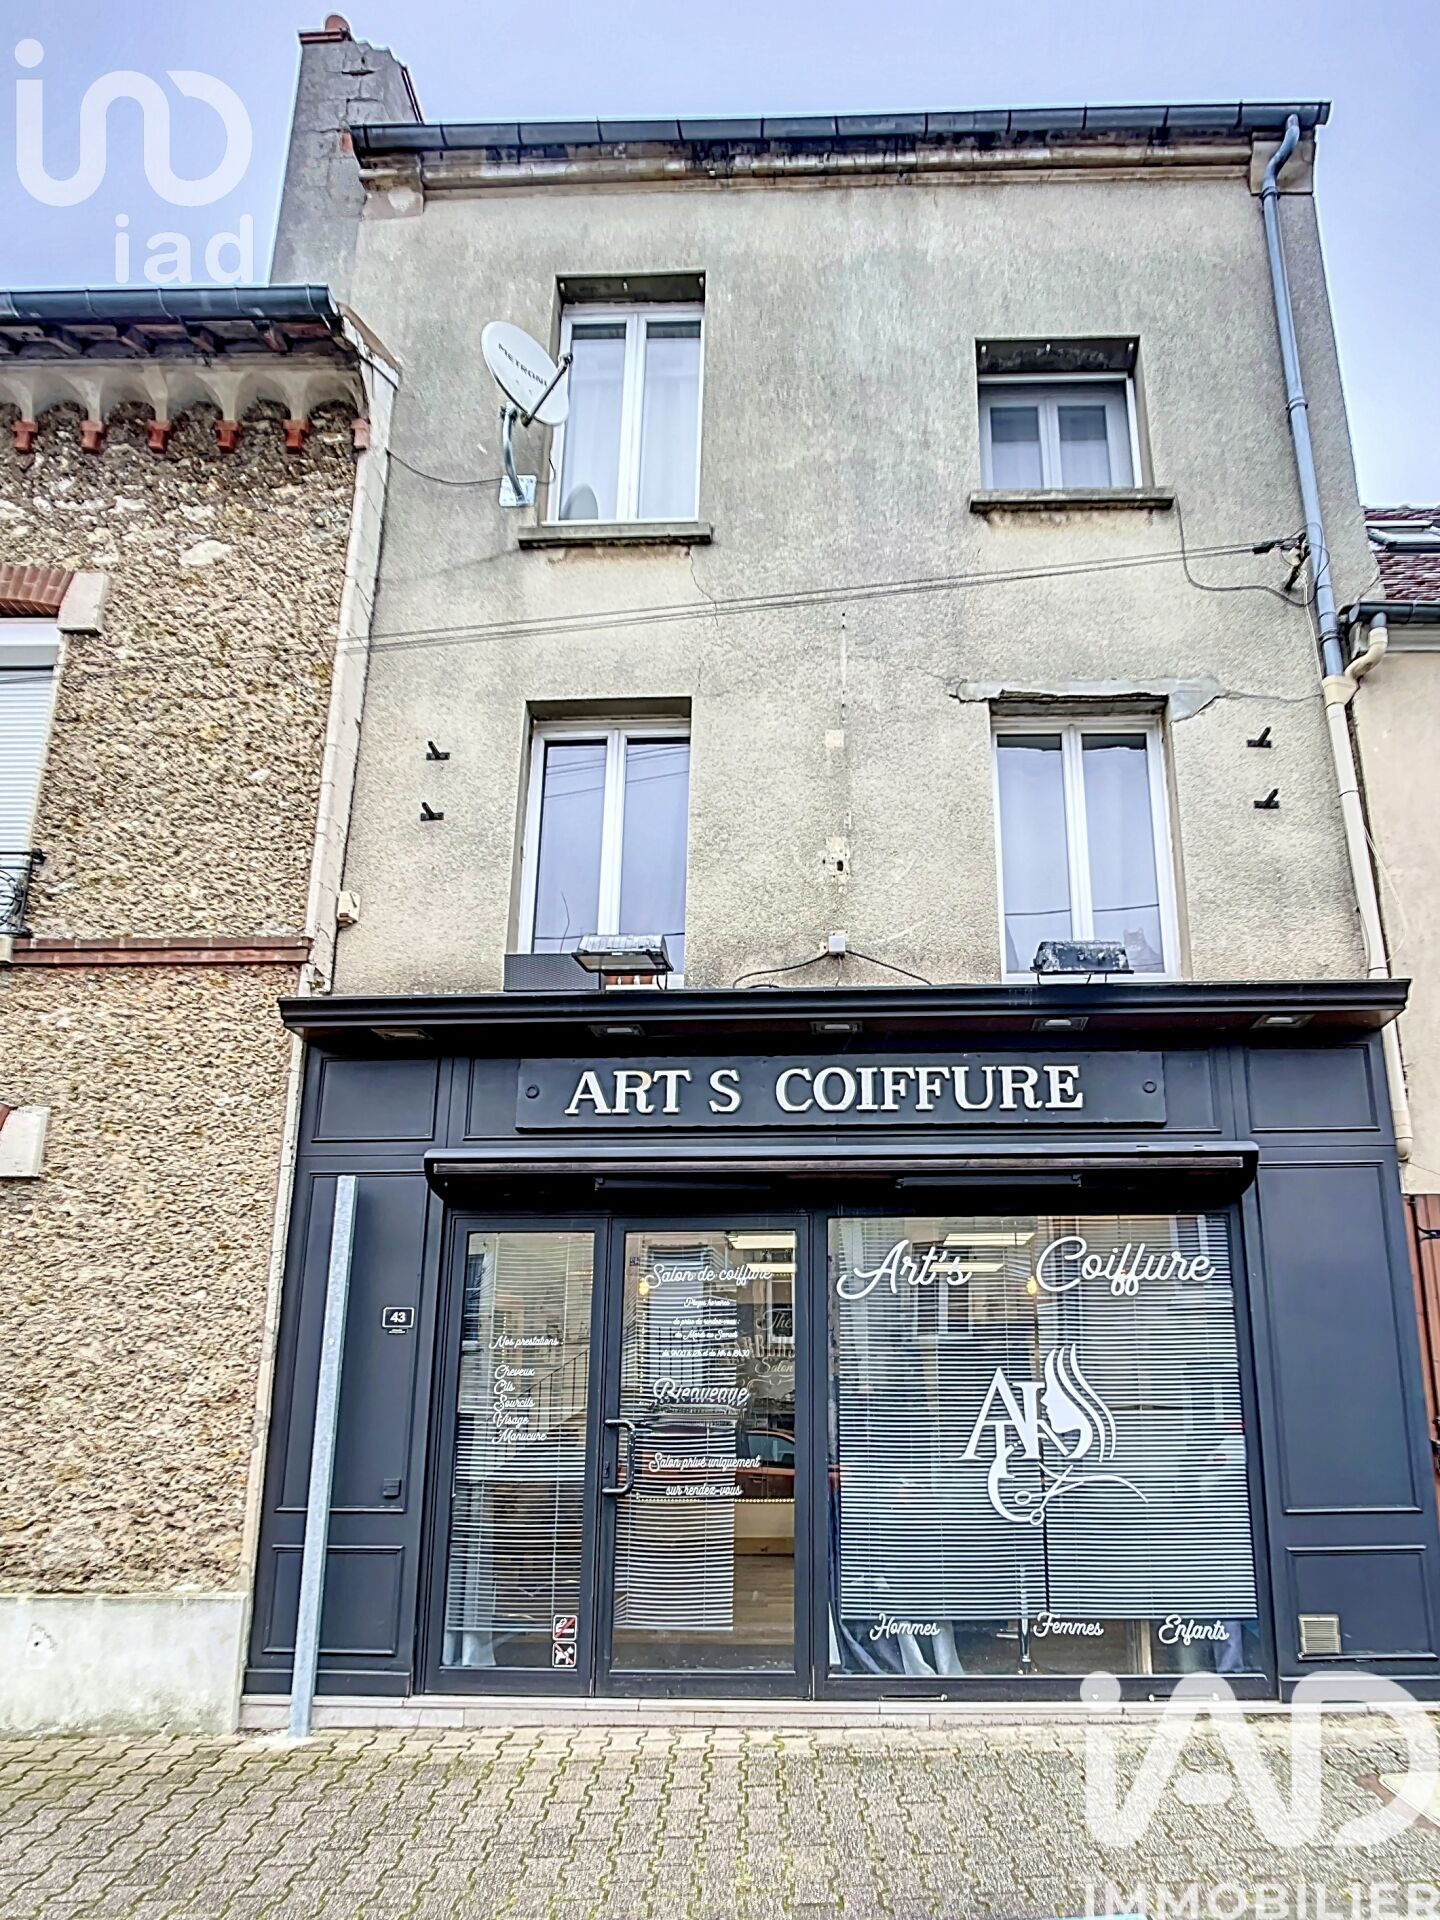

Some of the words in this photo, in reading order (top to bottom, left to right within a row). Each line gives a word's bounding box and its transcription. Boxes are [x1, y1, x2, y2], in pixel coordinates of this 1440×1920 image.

[565, 1070, 693, 1114] ART
[709, 1069, 741, 1113] S
[775, 1065, 1084, 1112] COIFFURE
[645, 1263, 694, 1288] Salon
[699, 1265, 717, 1281] de
[719, 1265, 773, 1286] coiffure
[837, 1240, 971, 1299] Art's
[1035, 1236, 1215, 1296] Coiffure
[390, 1311, 406, 1323] 43
[489, 1335, 514, 1349] Nos
[514, 1335, 559, 1348] prestations
[494, 1364, 536, 1379] Cheveux
[494, 1379, 515, 1395] Cils
[653, 1377, 750, 1405] Bienvenue
[493, 1394, 536, 1412] Sourcils
[493, 1411, 530, 1429] Visage
[491, 1428, 548, 1445] Manucure
[648, 1452, 681, 1472] Salon
[680, 1456, 706, 1471] privé
[707, 1455, 761, 1472] uniquement
[665, 1485, 683, 1496] sur
[683, 1482, 743, 1496] rendez-vous
[869, 1613, 941, 1640] Hommes
[1033, 1611, 1105, 1638] Femmes
[1158, 1614, 1231, 1645] Enfants
